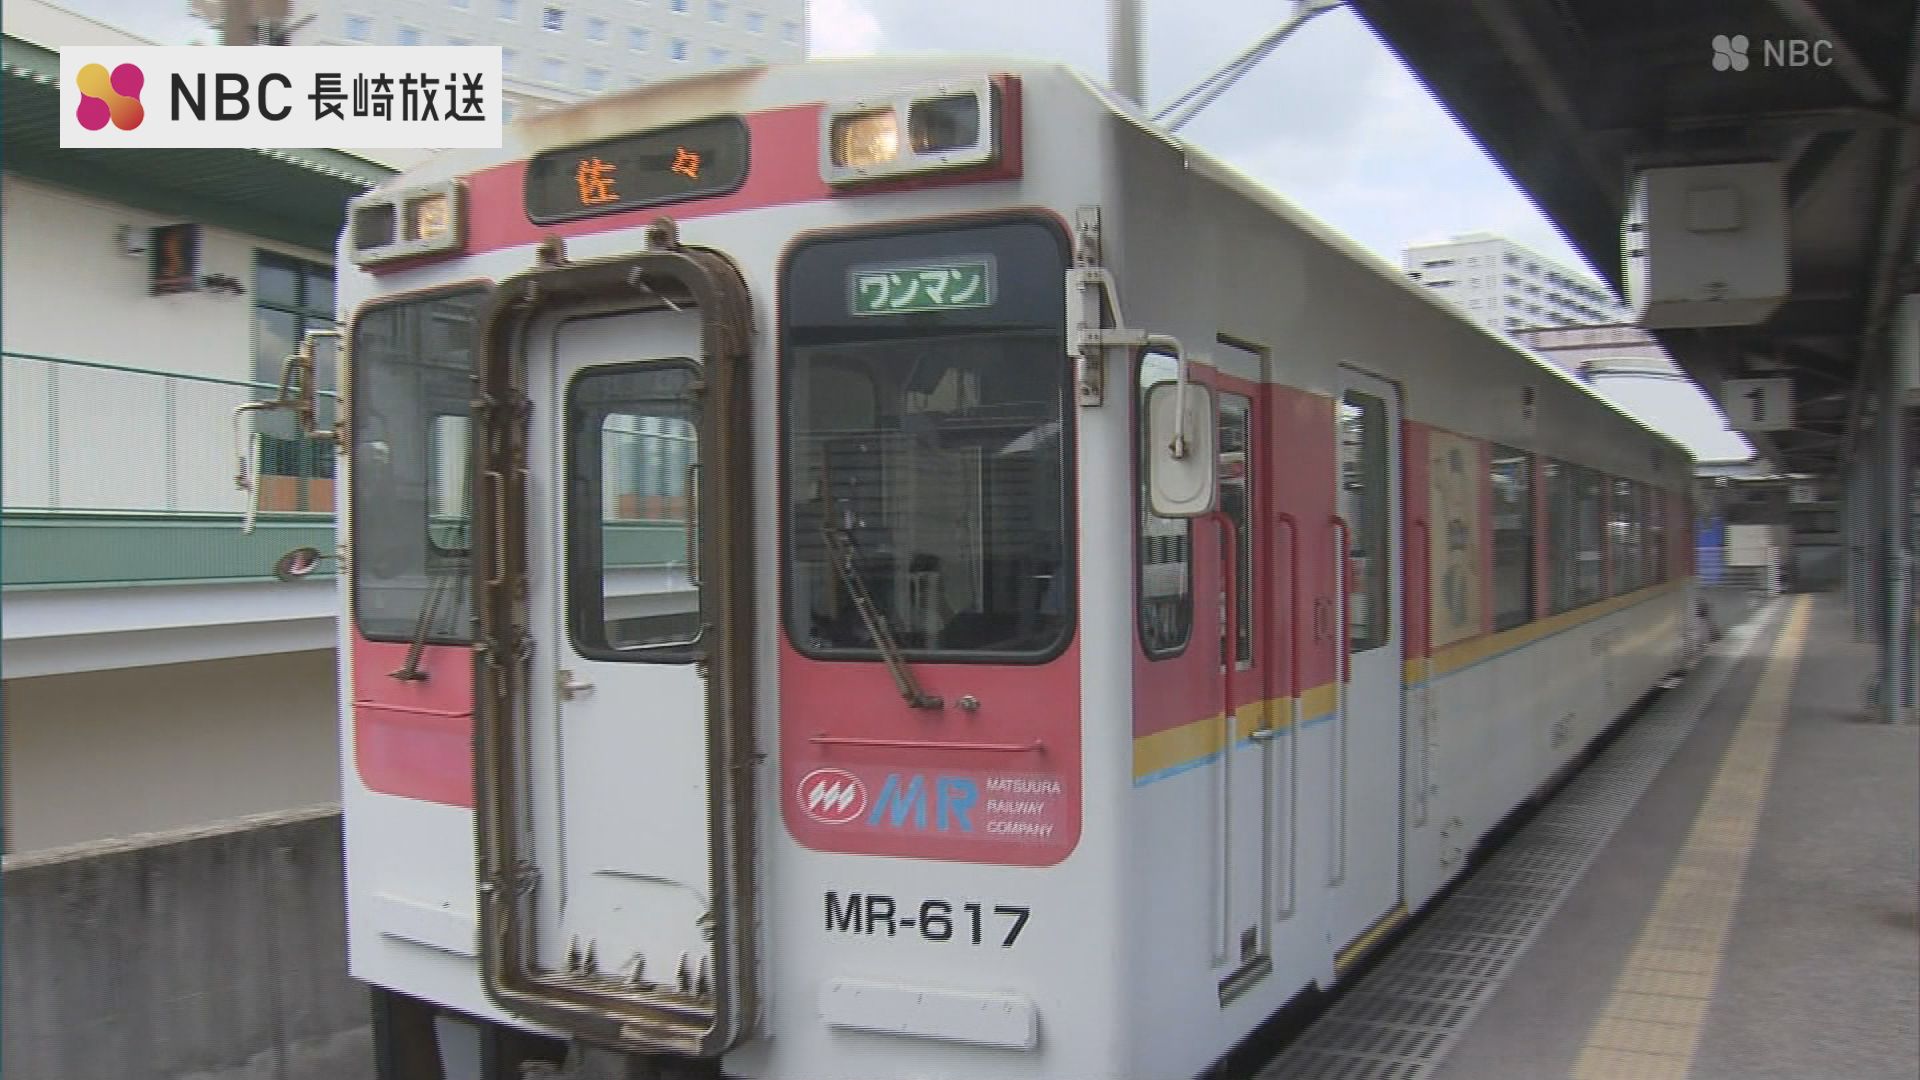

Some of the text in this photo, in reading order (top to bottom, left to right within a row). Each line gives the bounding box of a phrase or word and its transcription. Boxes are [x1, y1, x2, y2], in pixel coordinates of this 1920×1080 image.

[859, 268, 981, 309] ワンマン
[1745, 387, 1766, 422] 1
[867, 773, 980, 833] MR
[986, 776, 1062, 795] MATSUURA
[986, 800, 1045, 817] RAILWAY
[986, 820, 1055, 840] COMPANY
[824, 890, 1031, 948] MR-617
